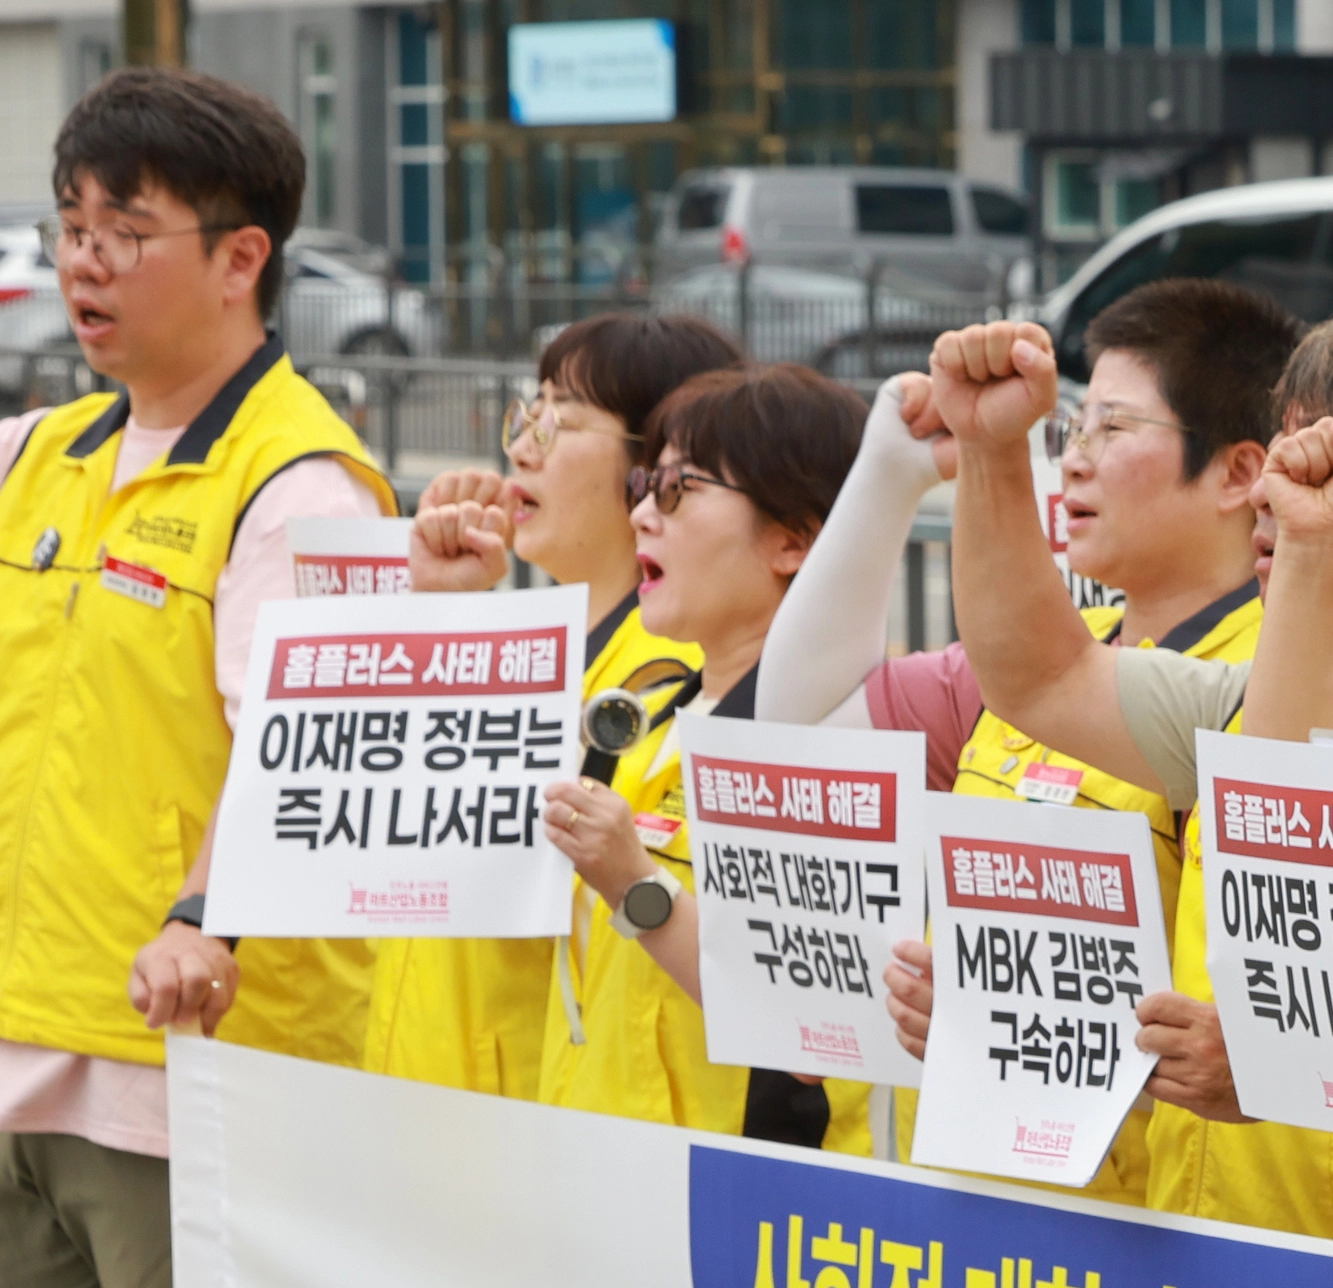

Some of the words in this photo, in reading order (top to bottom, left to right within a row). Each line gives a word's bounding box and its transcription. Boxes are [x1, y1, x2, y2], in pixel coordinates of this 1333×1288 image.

[283, 642, 414, 688] 홈플러스
[422, 642, 493, 685] 사태
[498, 637, 558, 683] 해결
[260, 710, 408, 773] 이재명
[423, 707, 563, 771] 정부는
[274, 787, 373, 851] 즉시
[386, 785, 539, 848] 나서라
[697, 765, 775, 817] 홈플러스
[780, 777, 823, 824] 사태
[827, 780, 881, 829] 해결
[1223, 789, 1313, 849] 홈플러스
[703, 842, 777, 910] 사회적
[783, 855, 900, 924] 대화기구
[952, 848, 1037, 900] 홈플러스
[1041, 859, 1078, 906] 사태
[1081, 864, 1126, 912] 해결
[1220, 868, 1322, 951] 이재명
[748, 919, 873, 998] 구성하라
[955, 923, 1042, 996] MBK
[1049, 931, 1144, 1010] 김병주
[1244, 959, 1319, 1037] 즉시
[988, 1011, 1121, 1091] 구속하라
